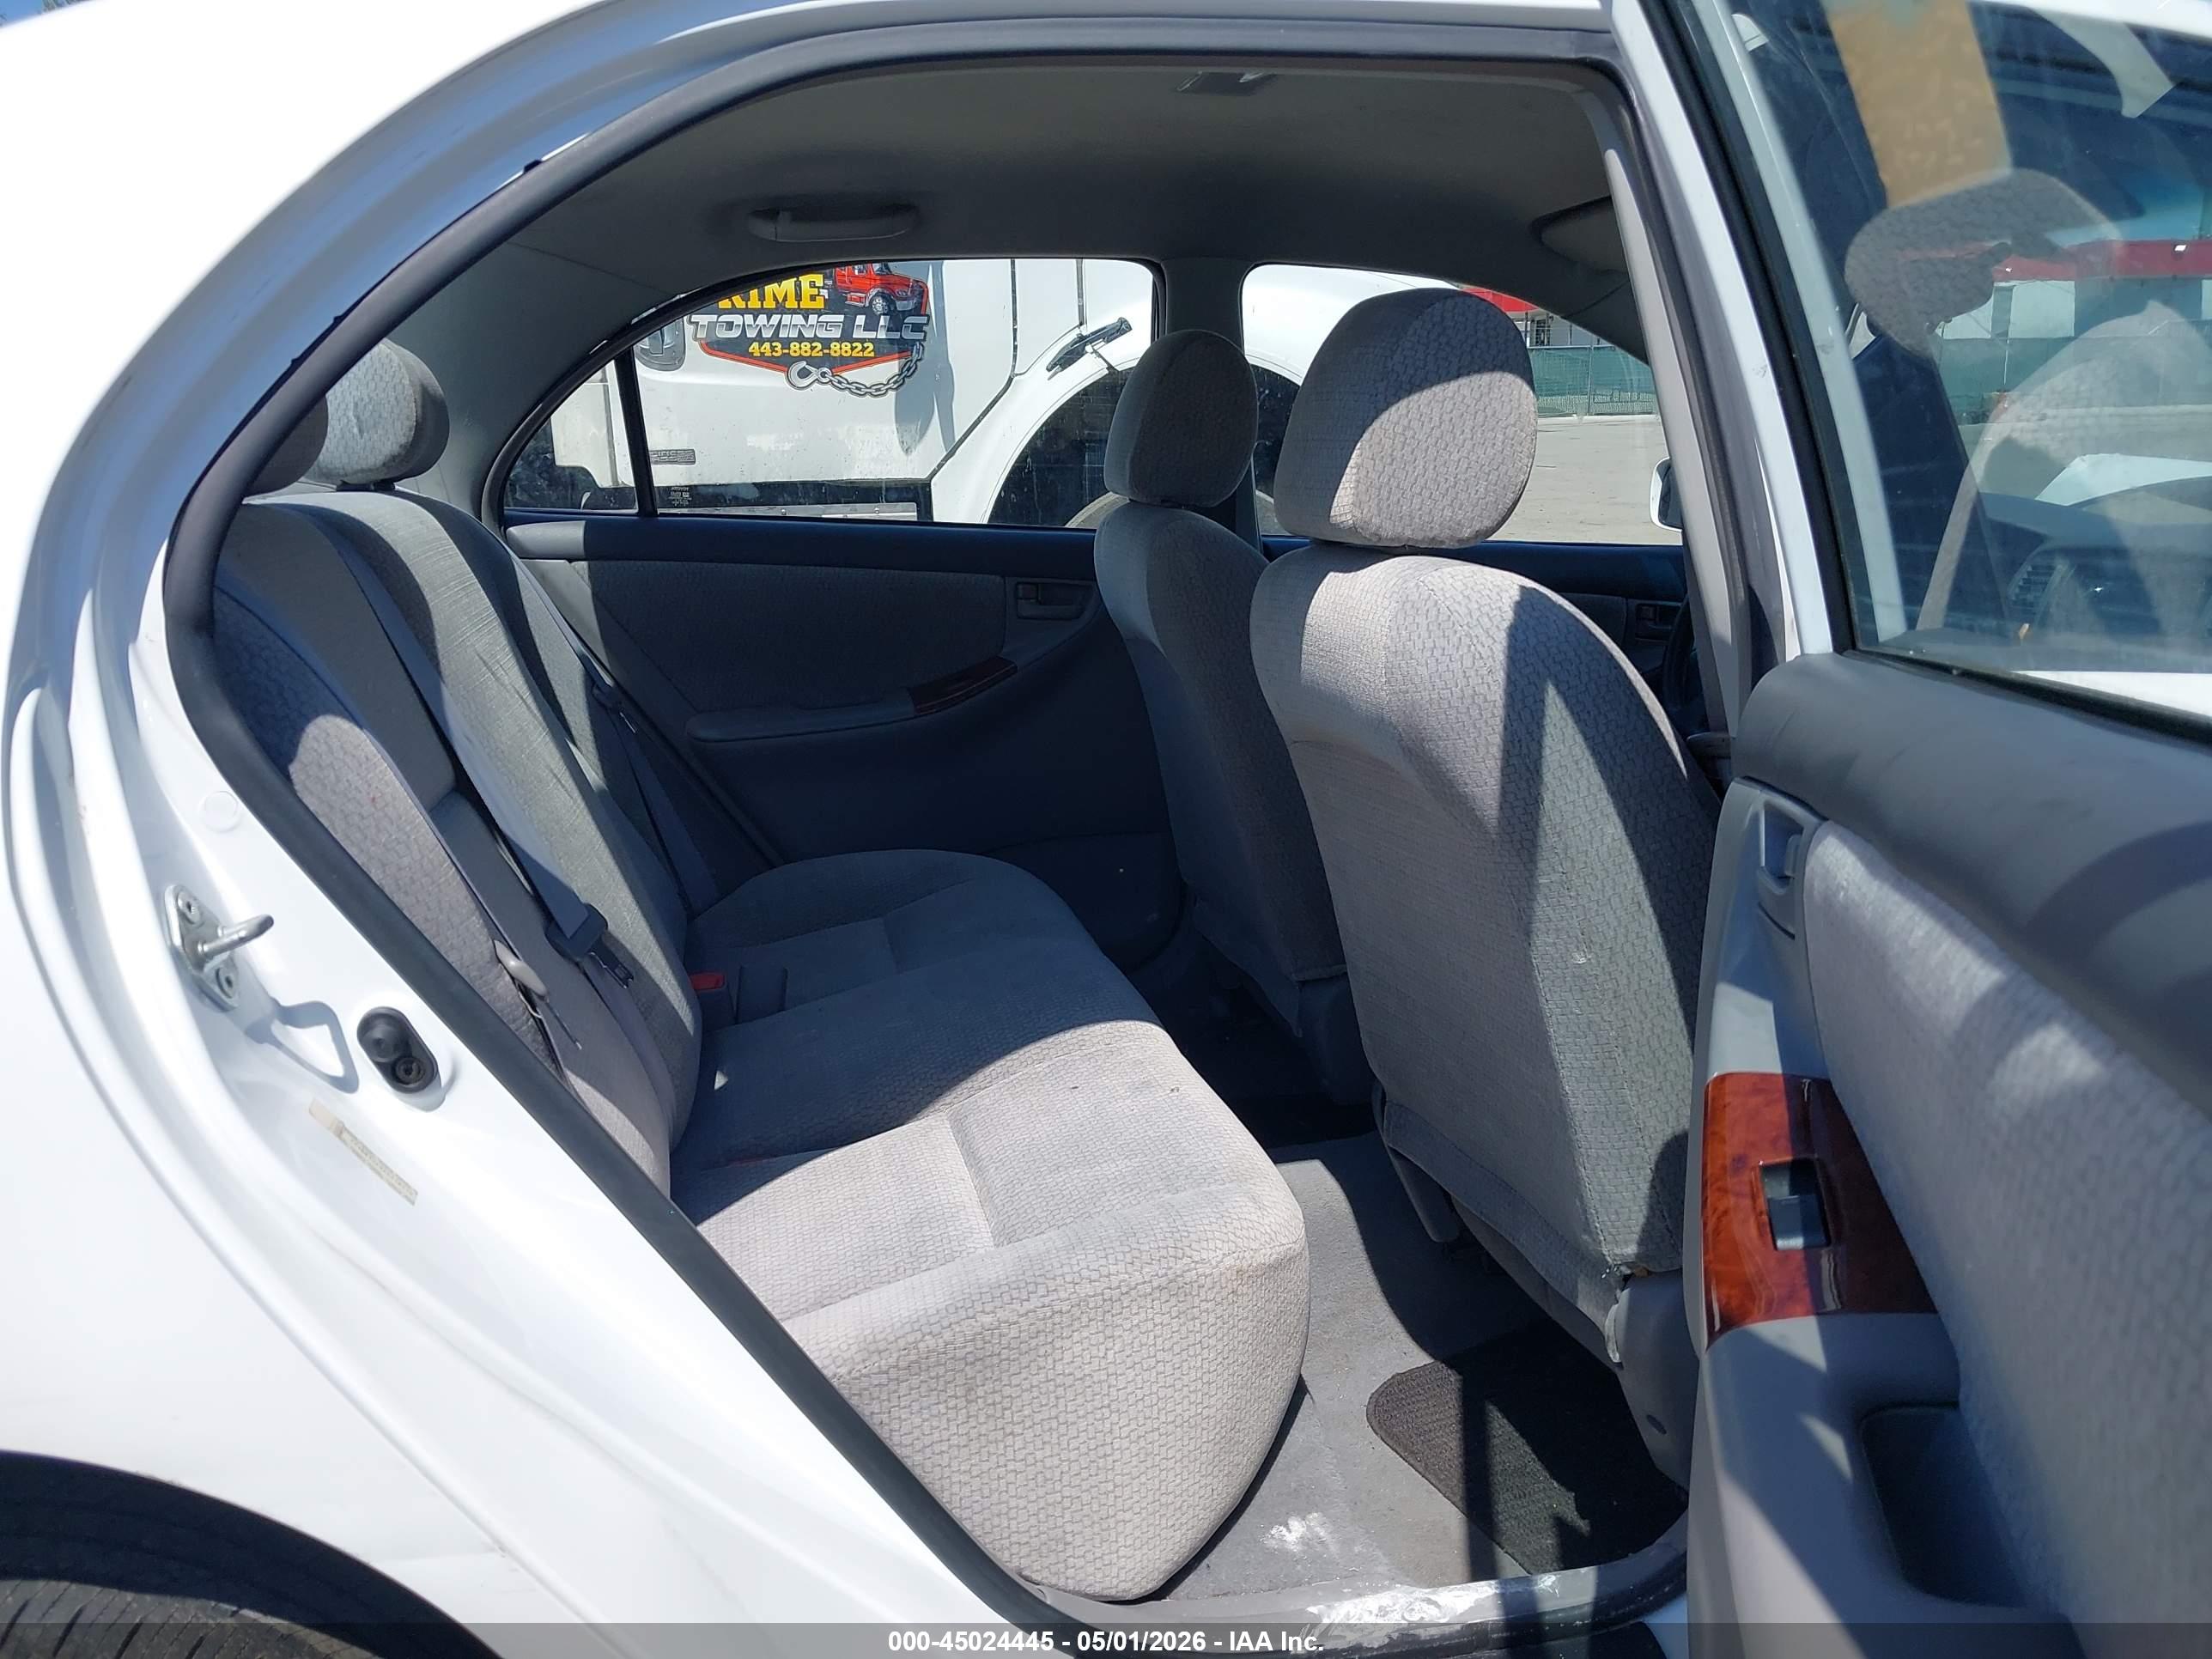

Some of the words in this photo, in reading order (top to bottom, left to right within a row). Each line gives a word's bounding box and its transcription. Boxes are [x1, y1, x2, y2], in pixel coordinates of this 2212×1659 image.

[691, 314, 845, 338] TOWING
[853, 314, 928, 340] LLC
[748, 341, 875, 357] 443-882-8822
